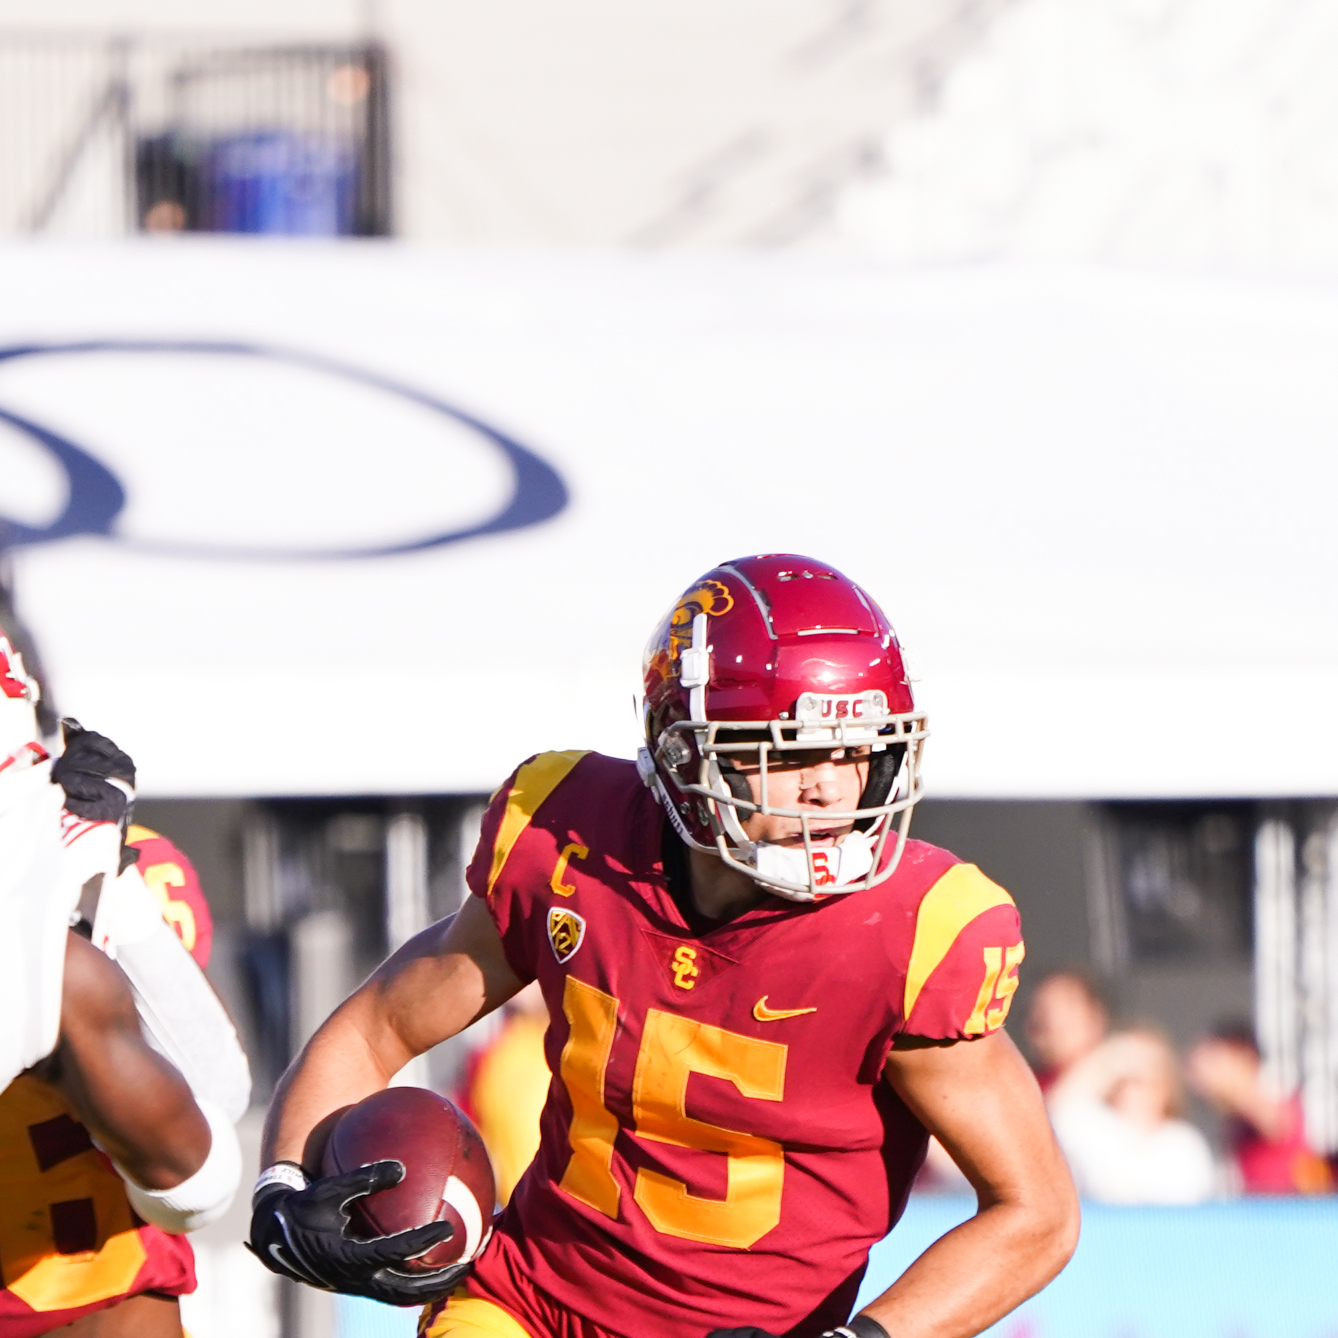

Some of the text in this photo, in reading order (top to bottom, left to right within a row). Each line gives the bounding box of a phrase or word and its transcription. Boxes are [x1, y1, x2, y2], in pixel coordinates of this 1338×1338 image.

[821, 699, 863, 719] USC
[550, 843, 589, 897] C
[963, 940, 1025, 1034] 15
[560, 975, 788, 1249] 15
